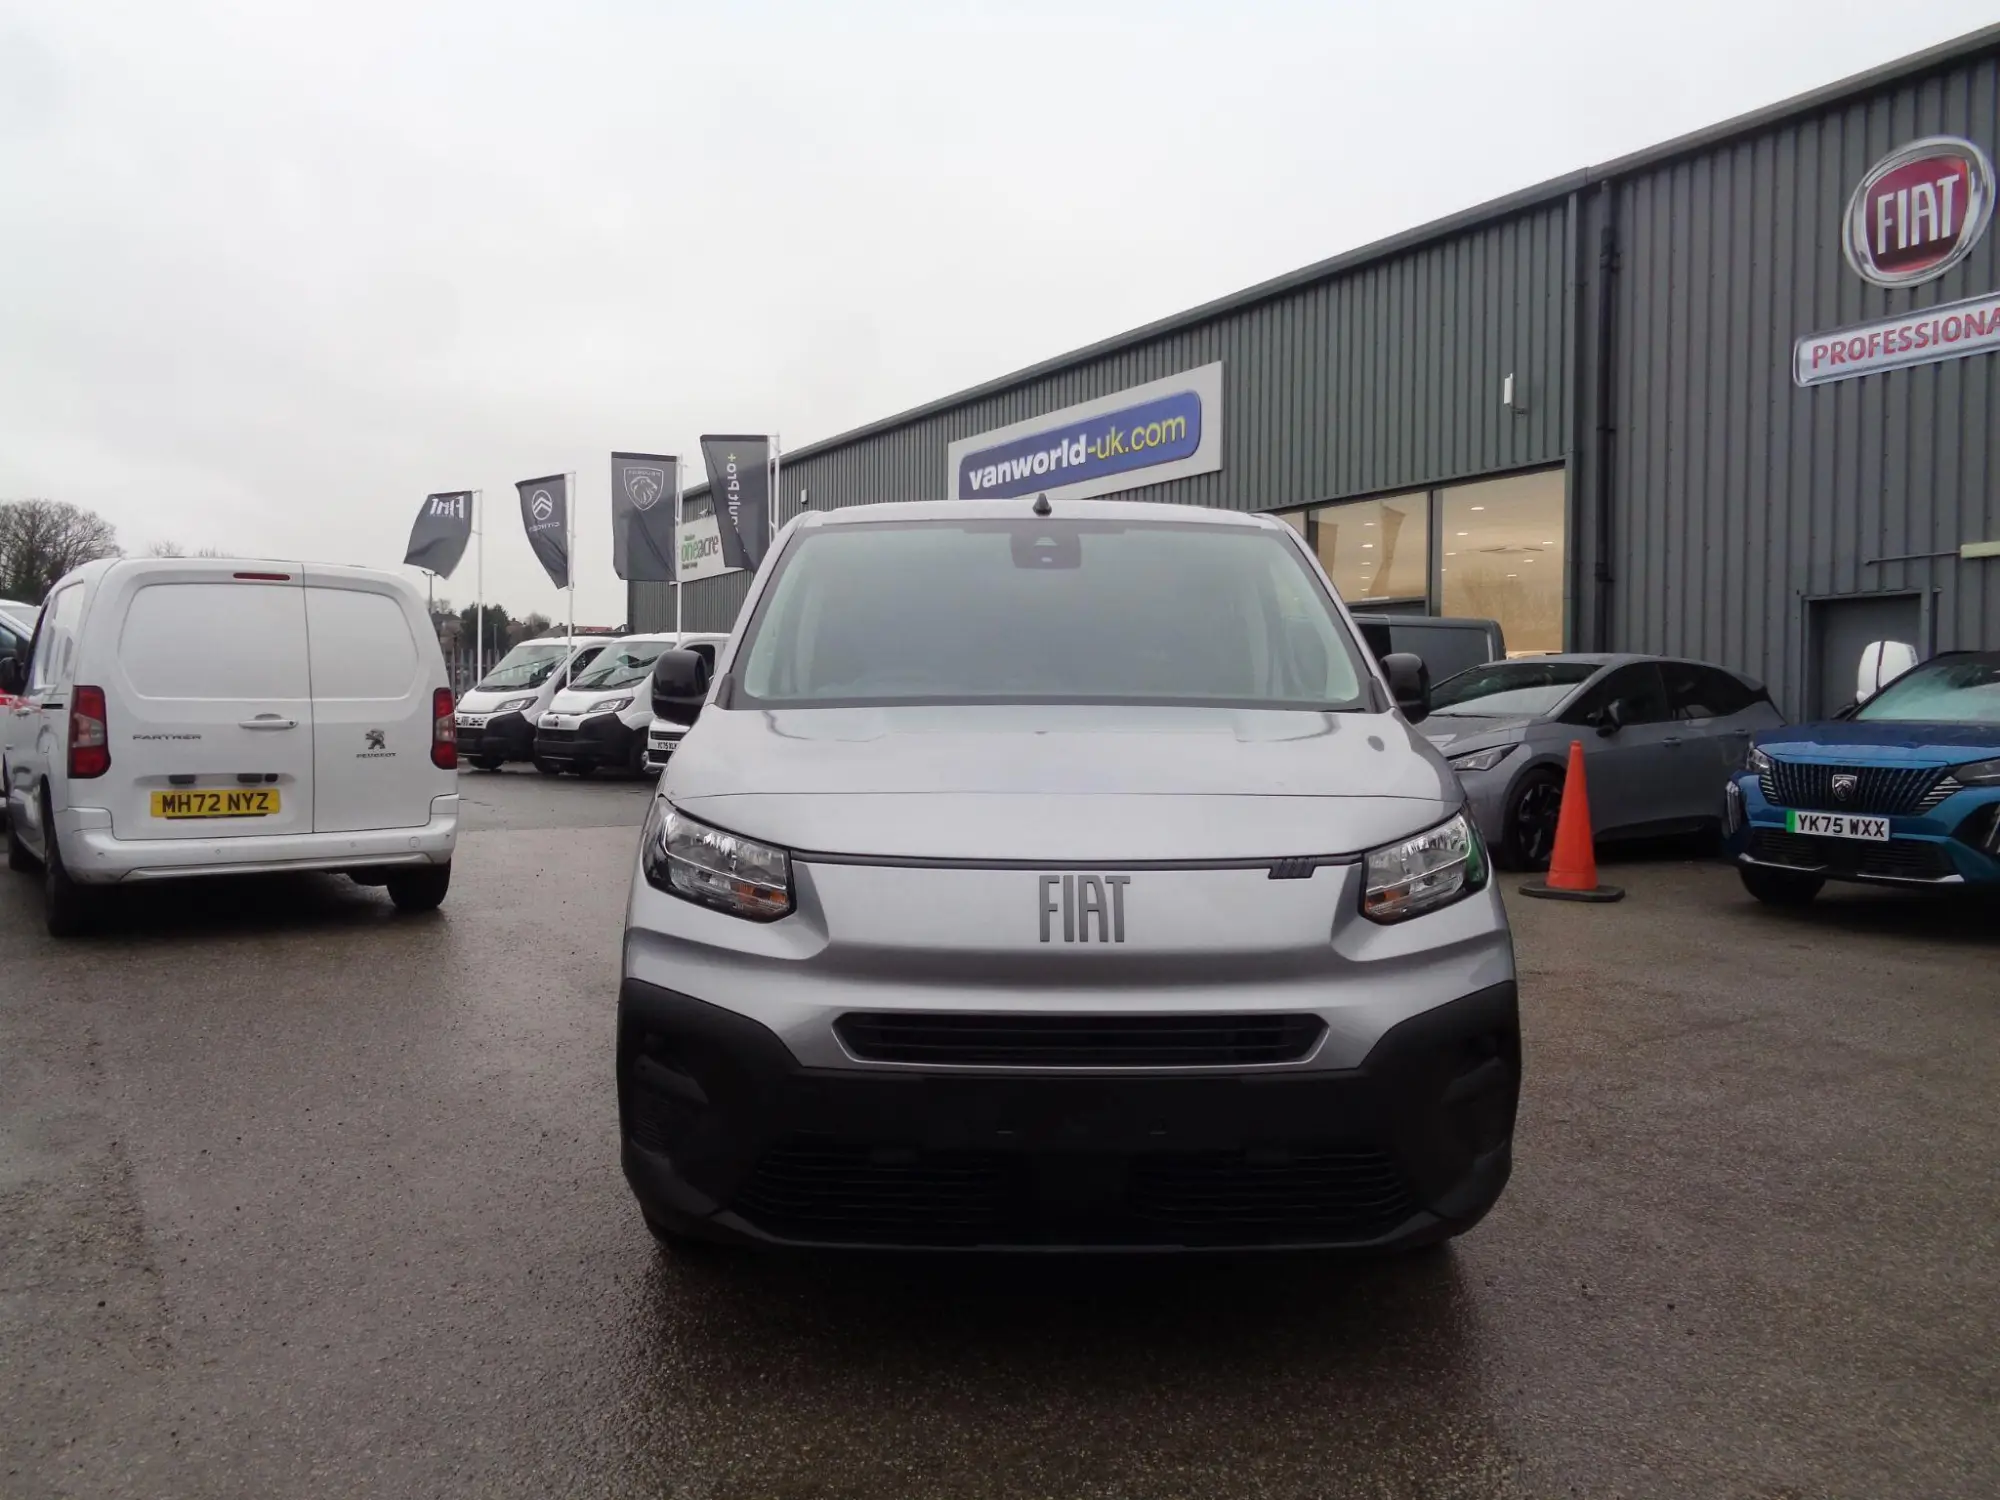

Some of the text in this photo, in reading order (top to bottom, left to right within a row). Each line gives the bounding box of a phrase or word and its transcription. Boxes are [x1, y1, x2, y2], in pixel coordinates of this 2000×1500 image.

[1876, 173, 1960, 255] FIAT
[968, 415, 1187, 491] vanworld-uk.com
[161, 792, 269, 814] MH72 NYZ
[1797, 813, 1885, 838] YK75 WXX
[1038, 874, 1131, 943] FIAT
